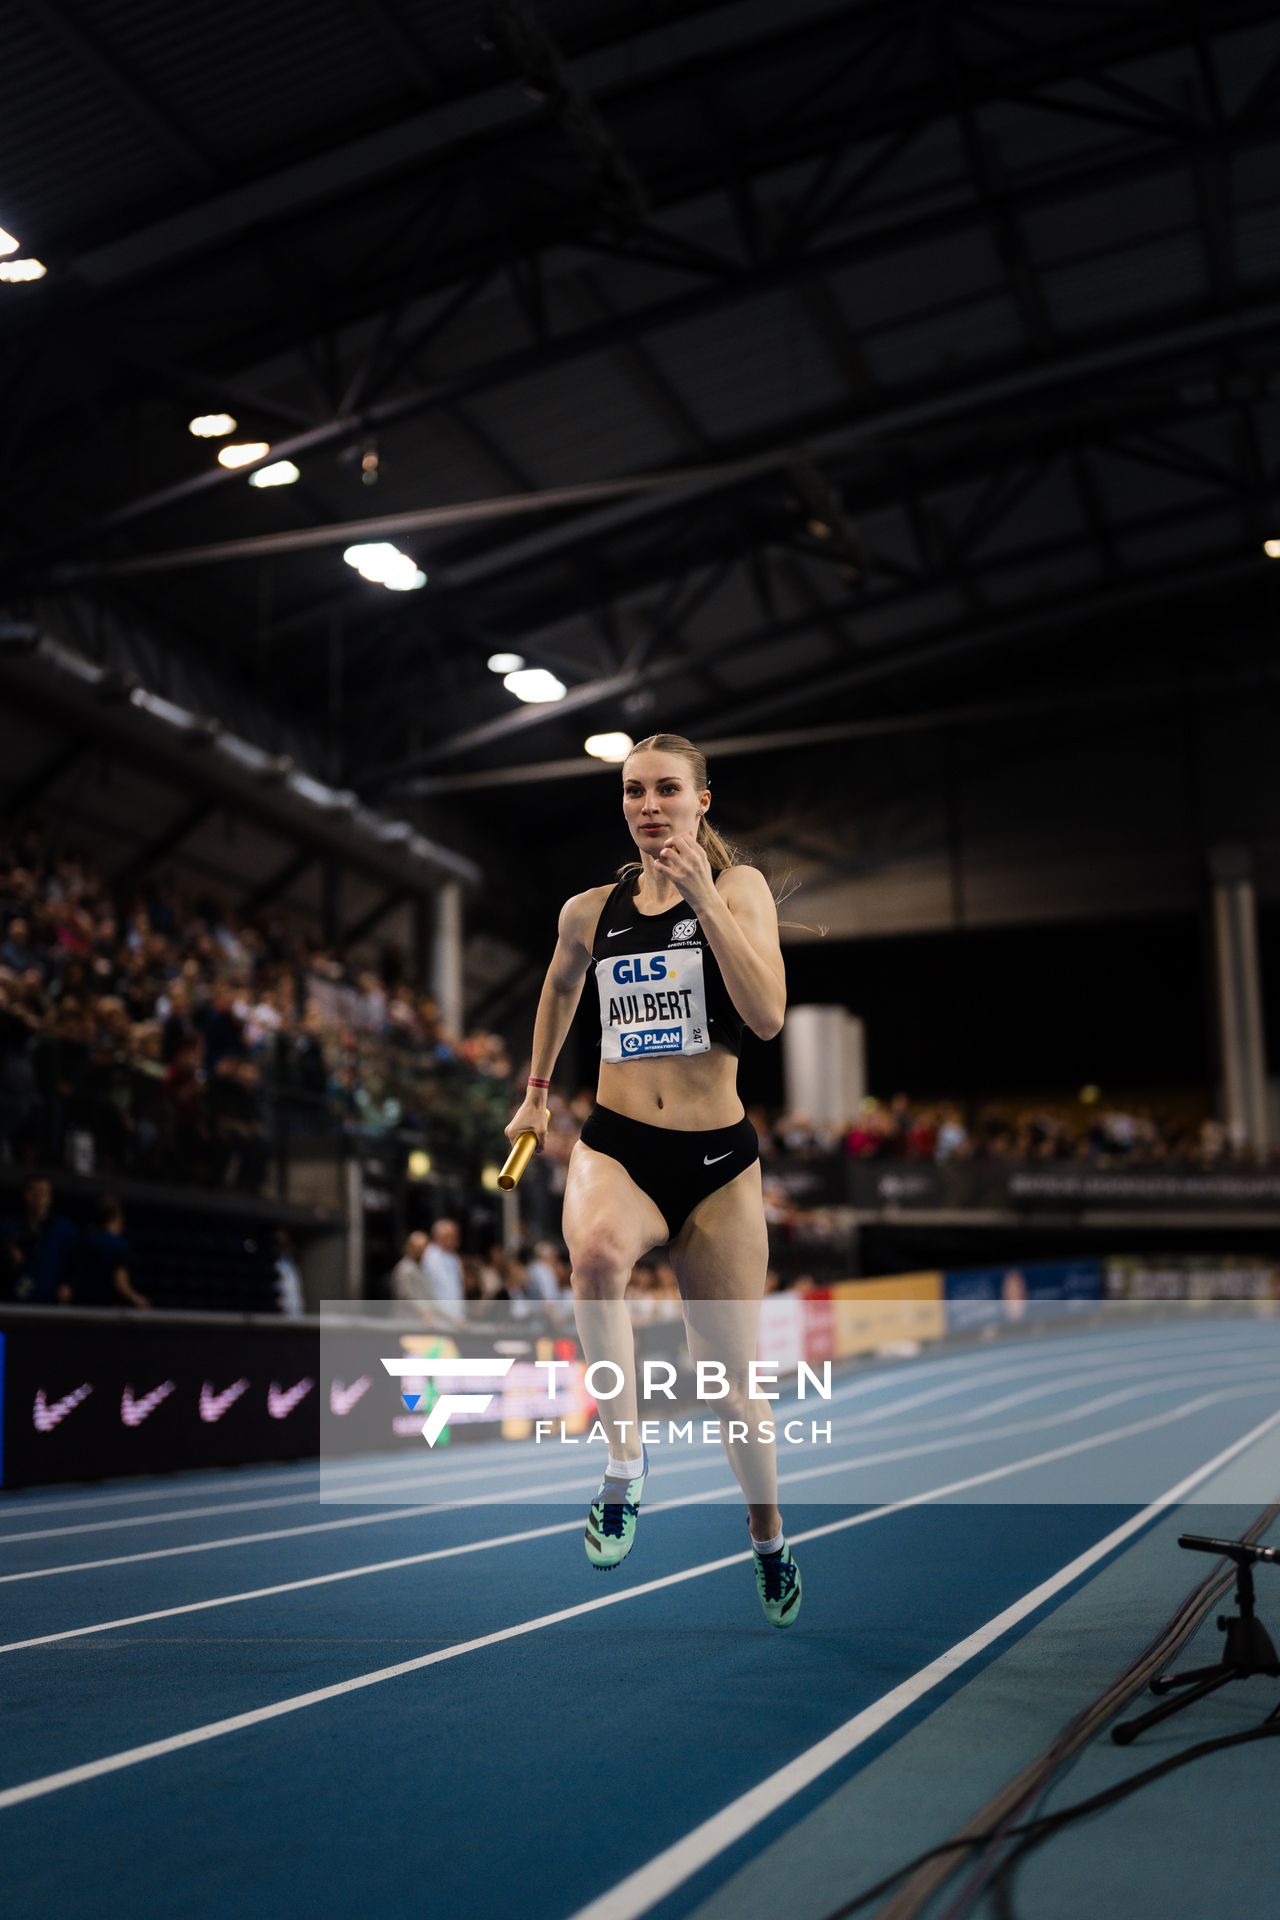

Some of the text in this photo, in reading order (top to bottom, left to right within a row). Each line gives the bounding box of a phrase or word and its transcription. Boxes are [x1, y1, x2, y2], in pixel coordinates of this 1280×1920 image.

[672, 919, 697, 940] 96
[609, 989, 691, 1026] AULBERT
[644, 1032, 680, 1044] PLAN
[693, 1028, 702, 1044] 247
